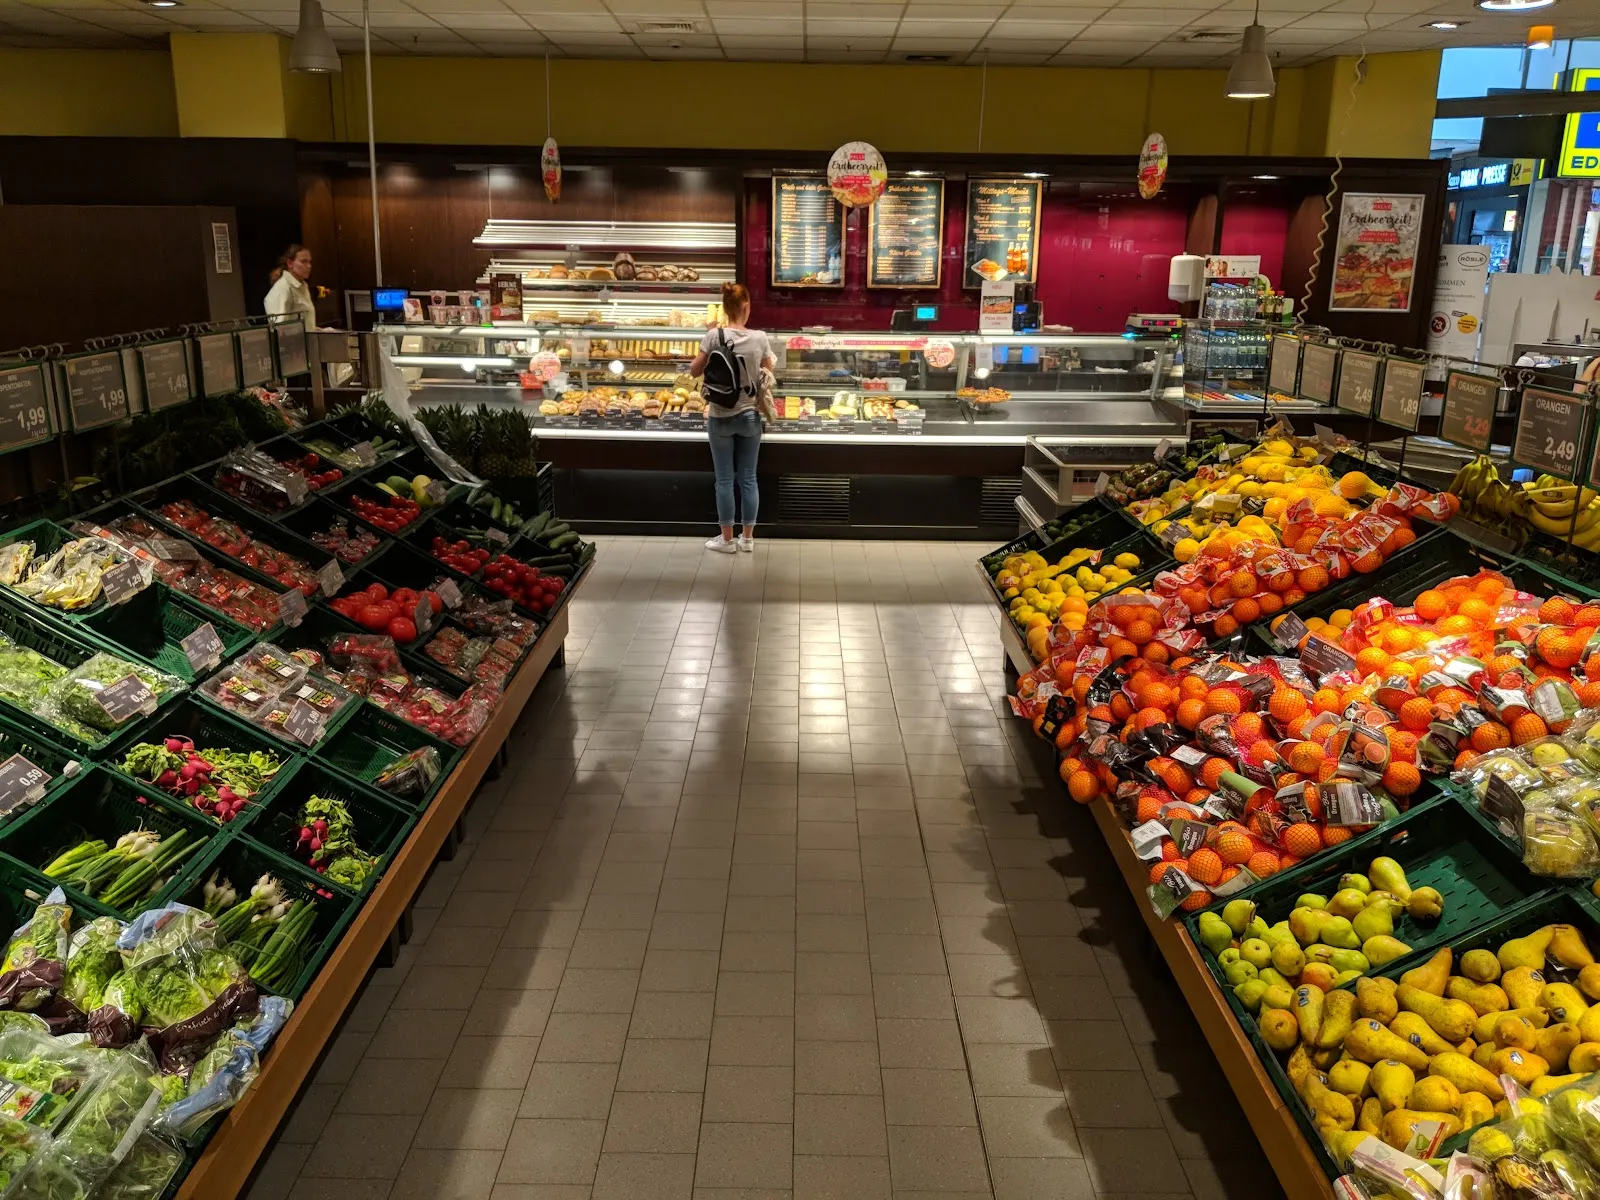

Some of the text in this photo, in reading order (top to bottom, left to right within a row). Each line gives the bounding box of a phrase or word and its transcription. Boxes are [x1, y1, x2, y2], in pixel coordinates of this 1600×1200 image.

[1348, 212, 1412, 227] Erdbeerzeit!
[1457, 380, 1487, 396] ORANGEN
[99, 389, 125, 411] 1,99
[1400, 397, 1419, 416] 1,89
[1535, 398, 1571, 416] ORANGEN
[17, 405, 46, 432] 1,99
[1543, 436, 1576, 460] 2,49
[127, 573, 142, 588] 1,29
[206, 638, 221, 653] 1,99
[1322, 644, 1349, 662] ORANGEN
[130, 688, 151, 703] 0,39
[19, 768, 43, 787] 0,59
